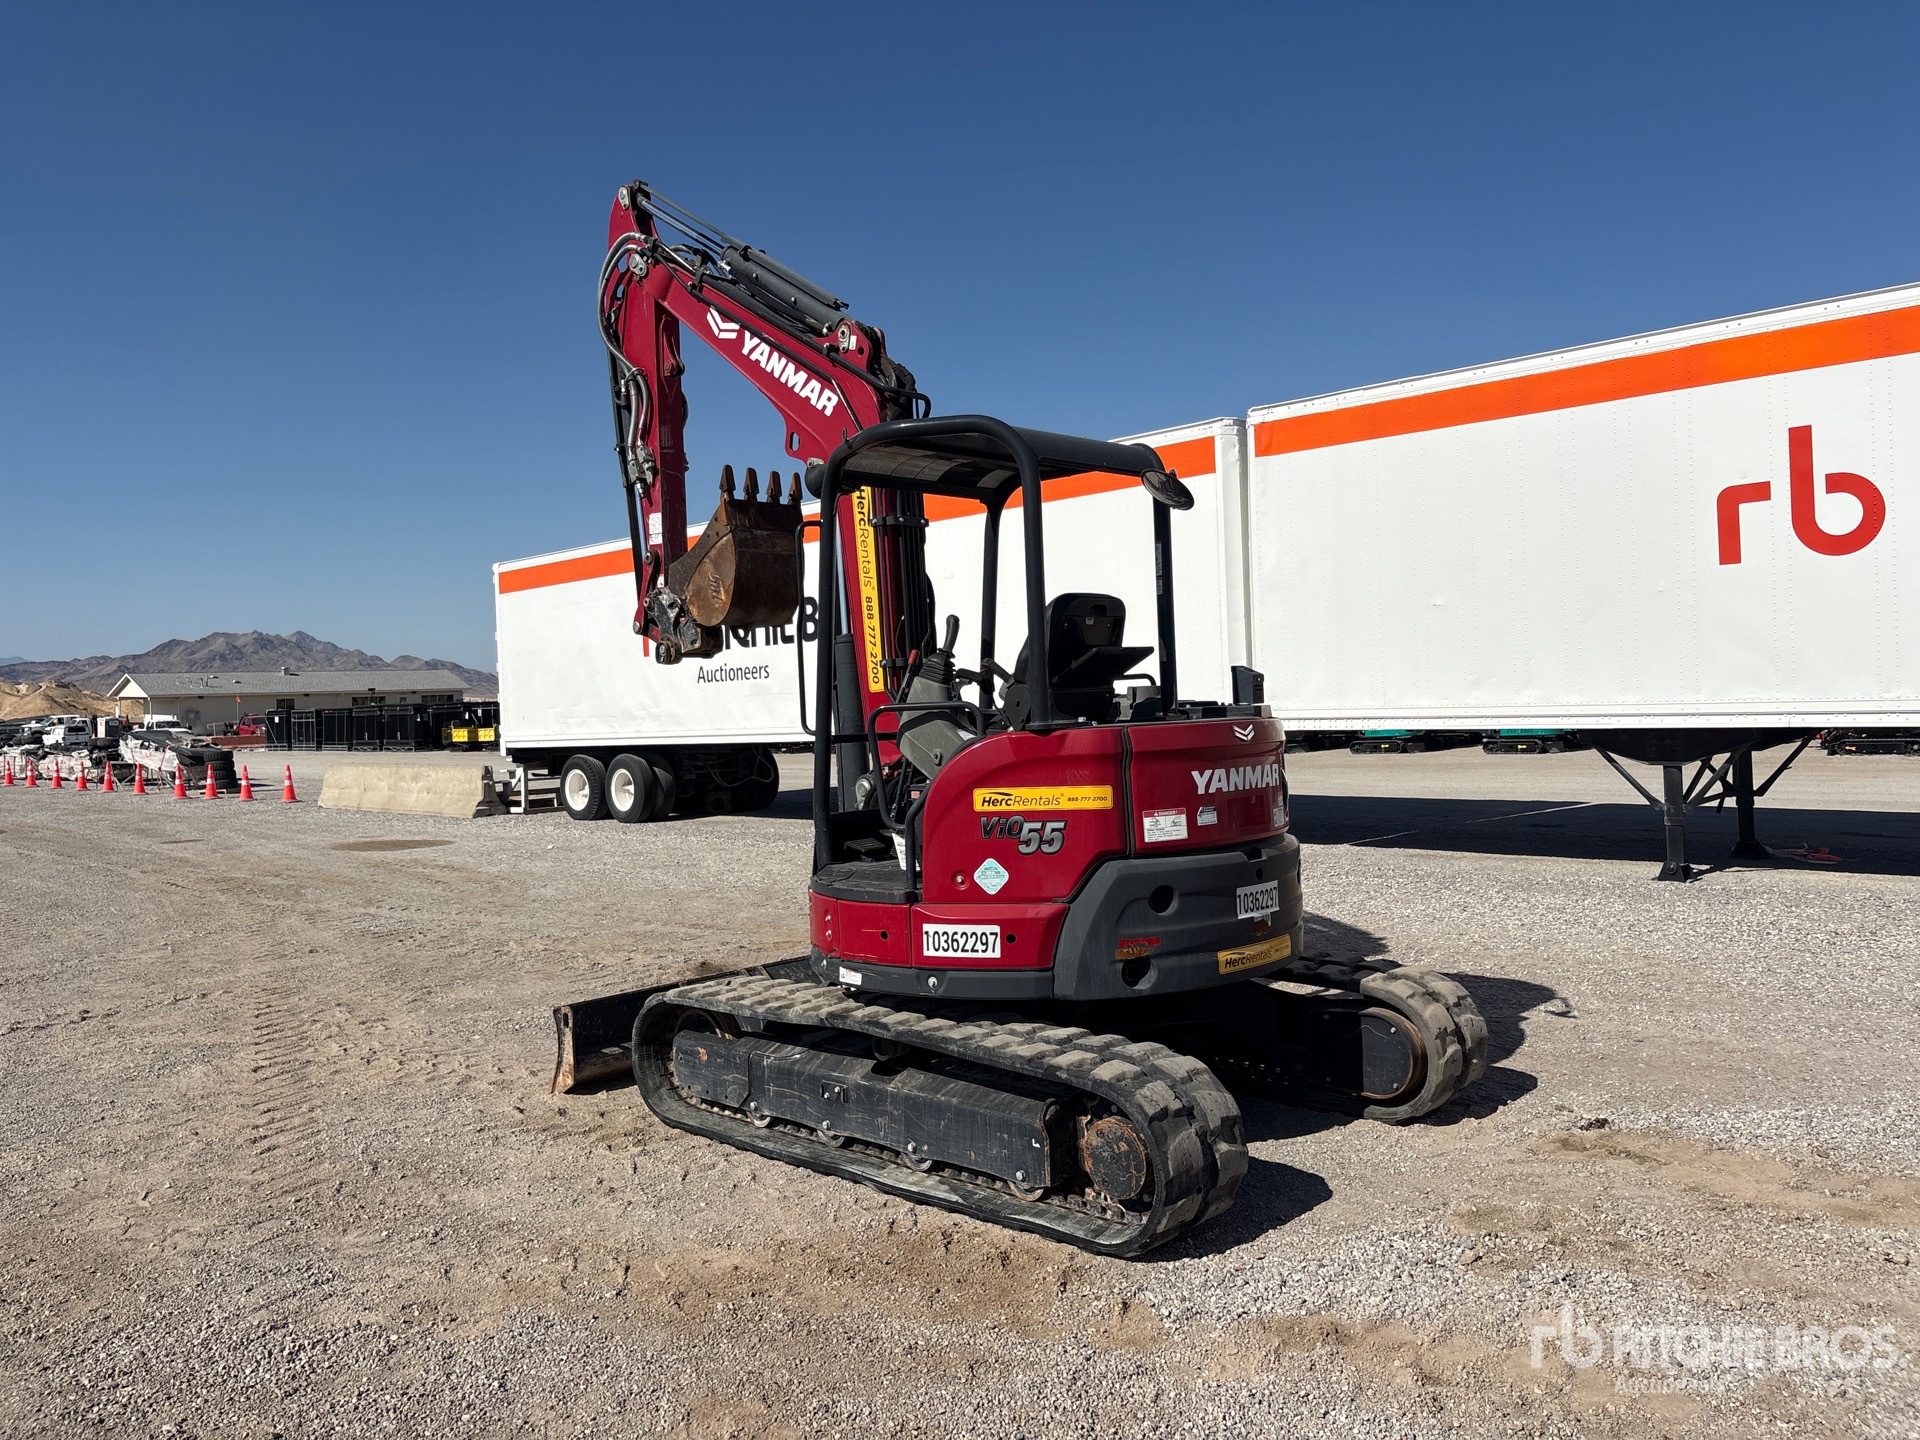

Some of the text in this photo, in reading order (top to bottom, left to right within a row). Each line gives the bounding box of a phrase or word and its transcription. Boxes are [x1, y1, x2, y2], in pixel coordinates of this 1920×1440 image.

[741, 330, 839, 417] YANMAR
[1717, 425, 1886, 565] rb
[865, 596, 880, 685] 888-777-2700
[697, 663, 770, 684] Auctioneers
[1191, 763, 1280, 794] YANMAR
[981, 795, 1061, 807] HercRentals
[1237, 886, 1278, 914] 10362297
[924, 930, 999, 953] 10362297
